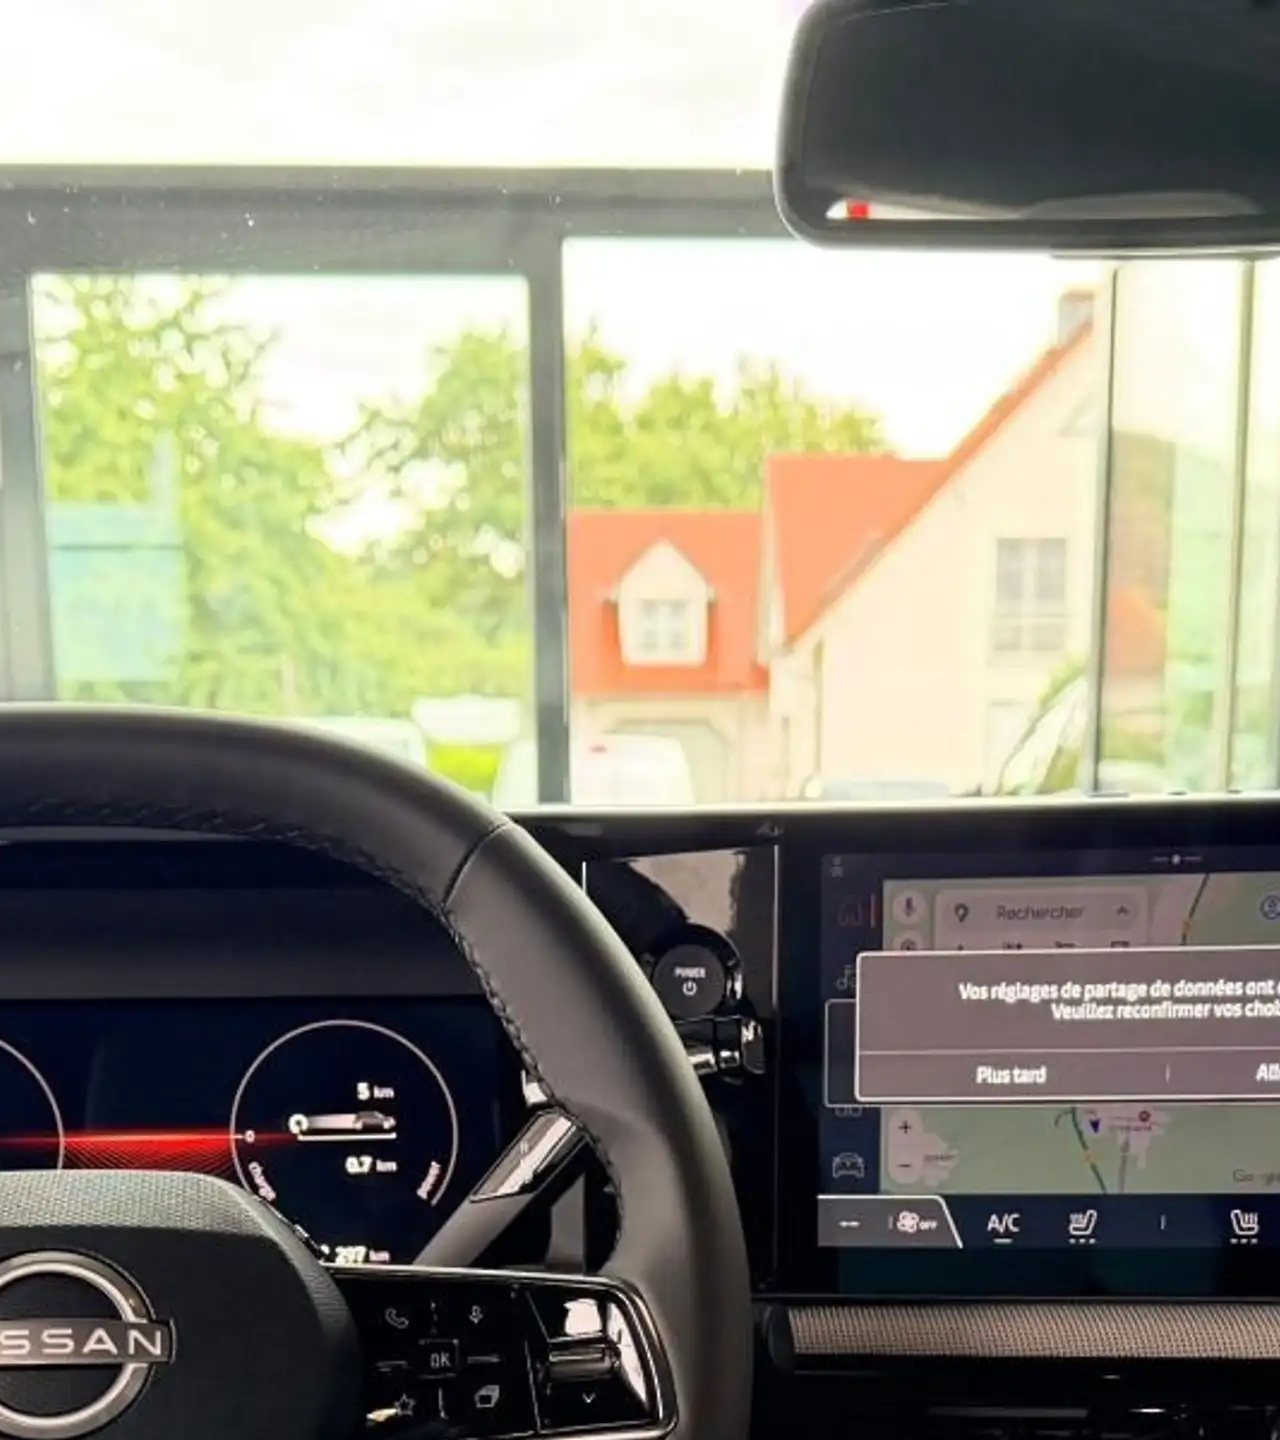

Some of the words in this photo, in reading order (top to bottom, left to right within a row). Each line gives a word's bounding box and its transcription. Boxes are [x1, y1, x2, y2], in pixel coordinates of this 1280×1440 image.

[996, 904, 1083, 920] Rechercher
[958, 982, 988, 1000] Vos
[990, 981, 1058, 1004] réglages
[1060, 981, 1081, 999] de
[1083, 981, 1147, 1002] partage
[1149, 979, 1171, 998] de
[1173, 978, 1243, 997] données
[1245, 979, 1274, 996] ont
[1050, 1002, 1114, 1020] Veuillez
[1116, 1001, 1210, 1019] reconfirmer
[1213, 1003, 1243, 1017] vos
[975, 1065, 1011, 1084] Plus
[1013, 1065, 1047, 1084] tard
[356, 1082, 370, 1101] 5
[373, 1085, 395, 1099] km
[376, 1158, 398, 1173] km
[986, 1211, 1021, 1234] A/C
[369, 1249, 391, 1263] km
[429, 1351, 450, 1368] OK
